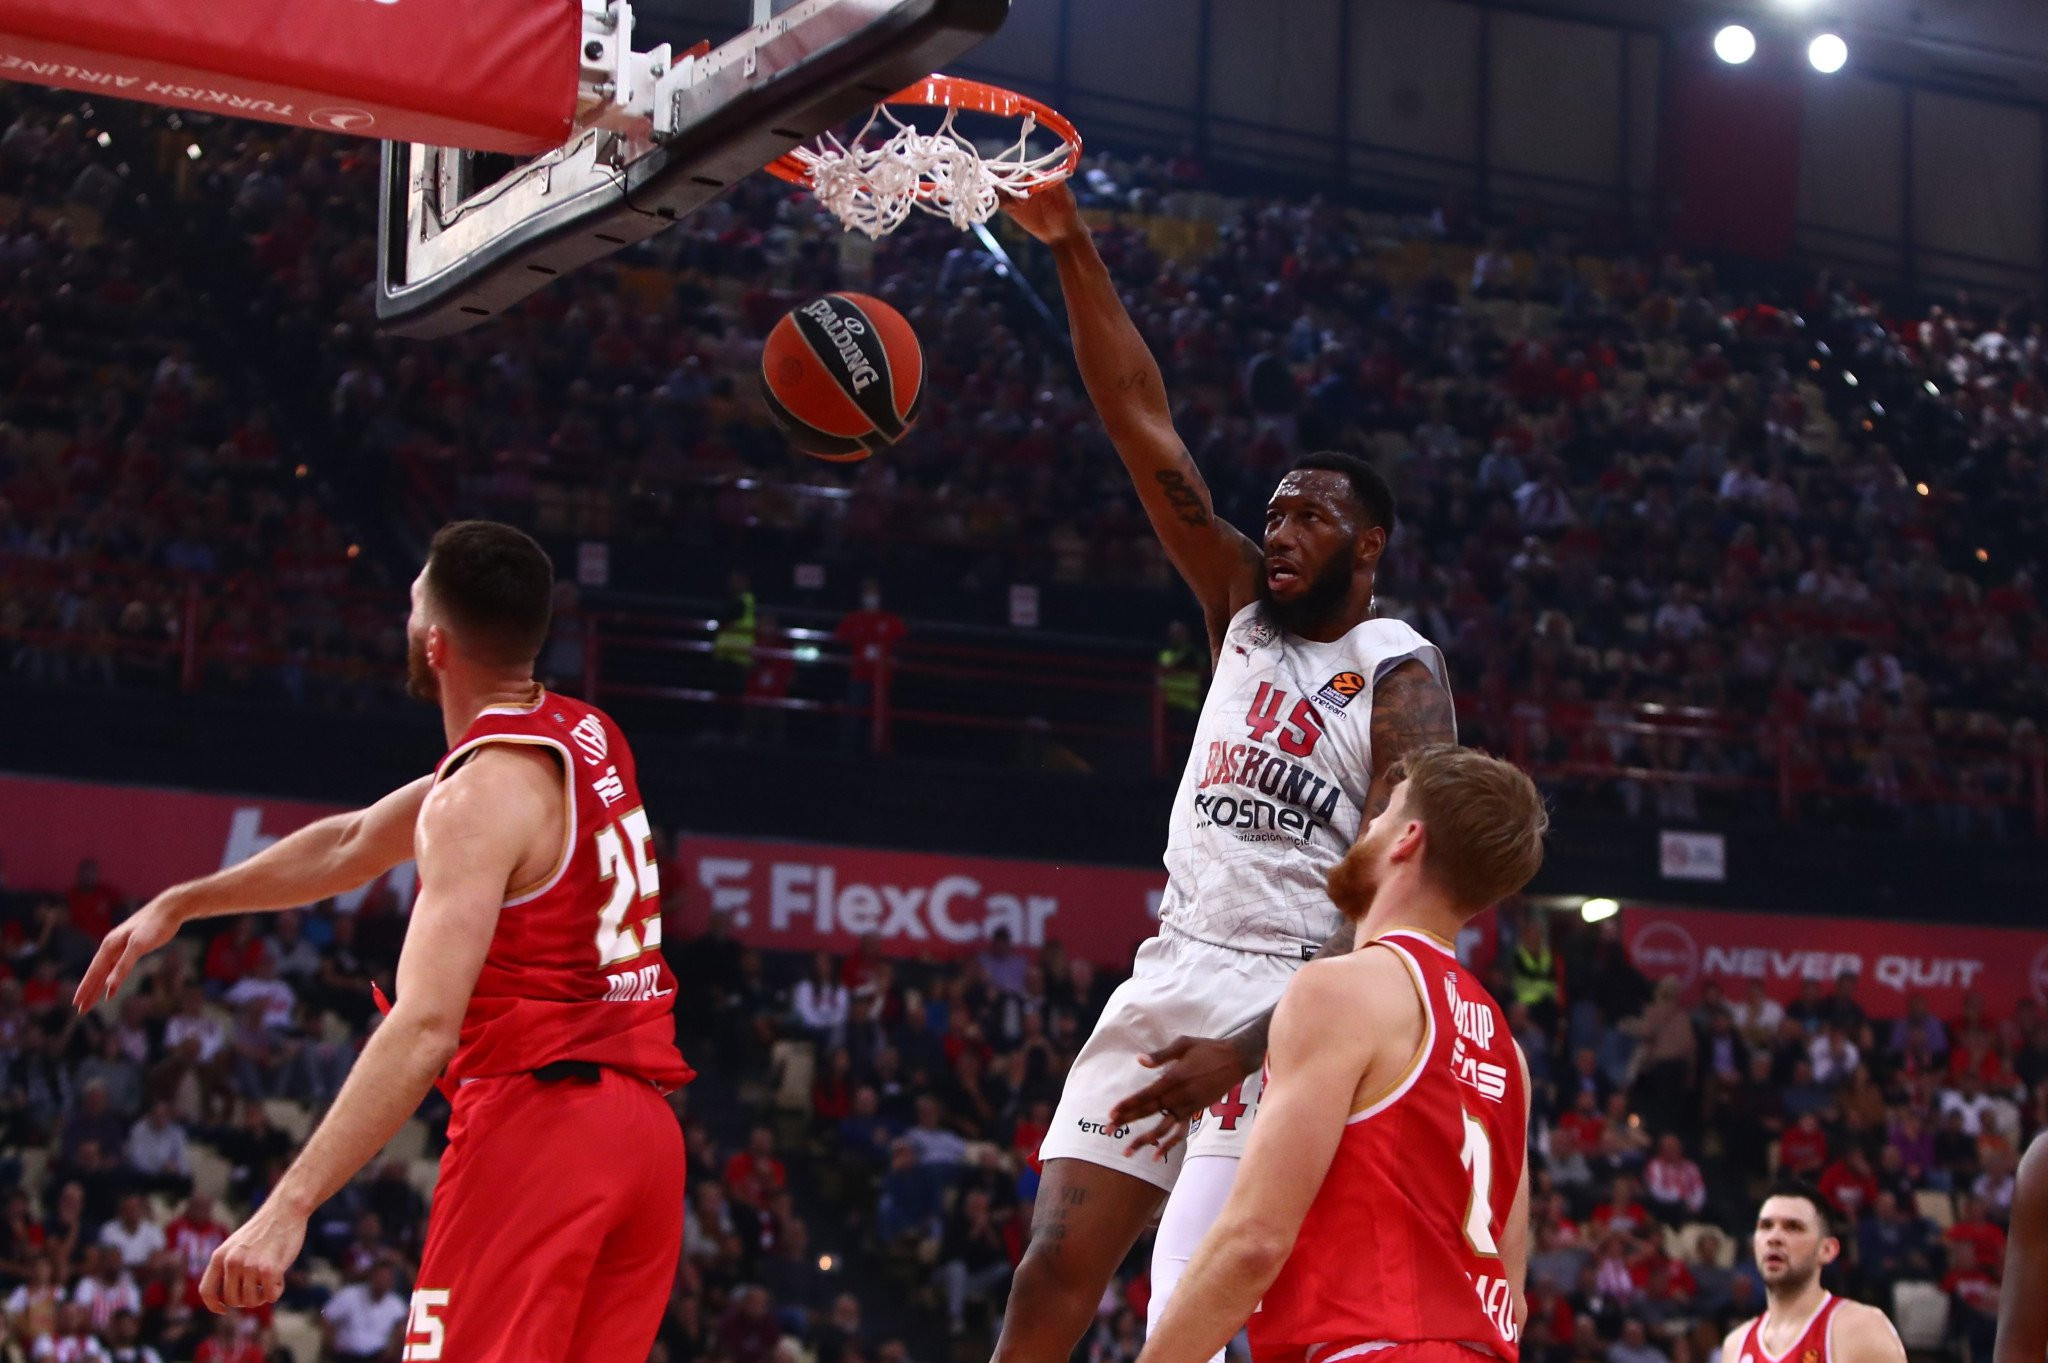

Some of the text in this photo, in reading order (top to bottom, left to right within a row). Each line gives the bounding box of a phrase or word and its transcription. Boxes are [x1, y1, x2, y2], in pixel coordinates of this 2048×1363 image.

[0, 55, 293, 116] TURKISH AIRLINE
[801, 299, 879, 395] SPALDING
[1246, 681, 1325, 759] 45
[1198, 741, 1342, 823] BASKONIA
[594, 804, 662, 971] 25
[770, 863, 1058, 947] FlexCar
[1703, 946, 1862, 981] NEVER
[1875, 955, 1983, 990] QUIT
